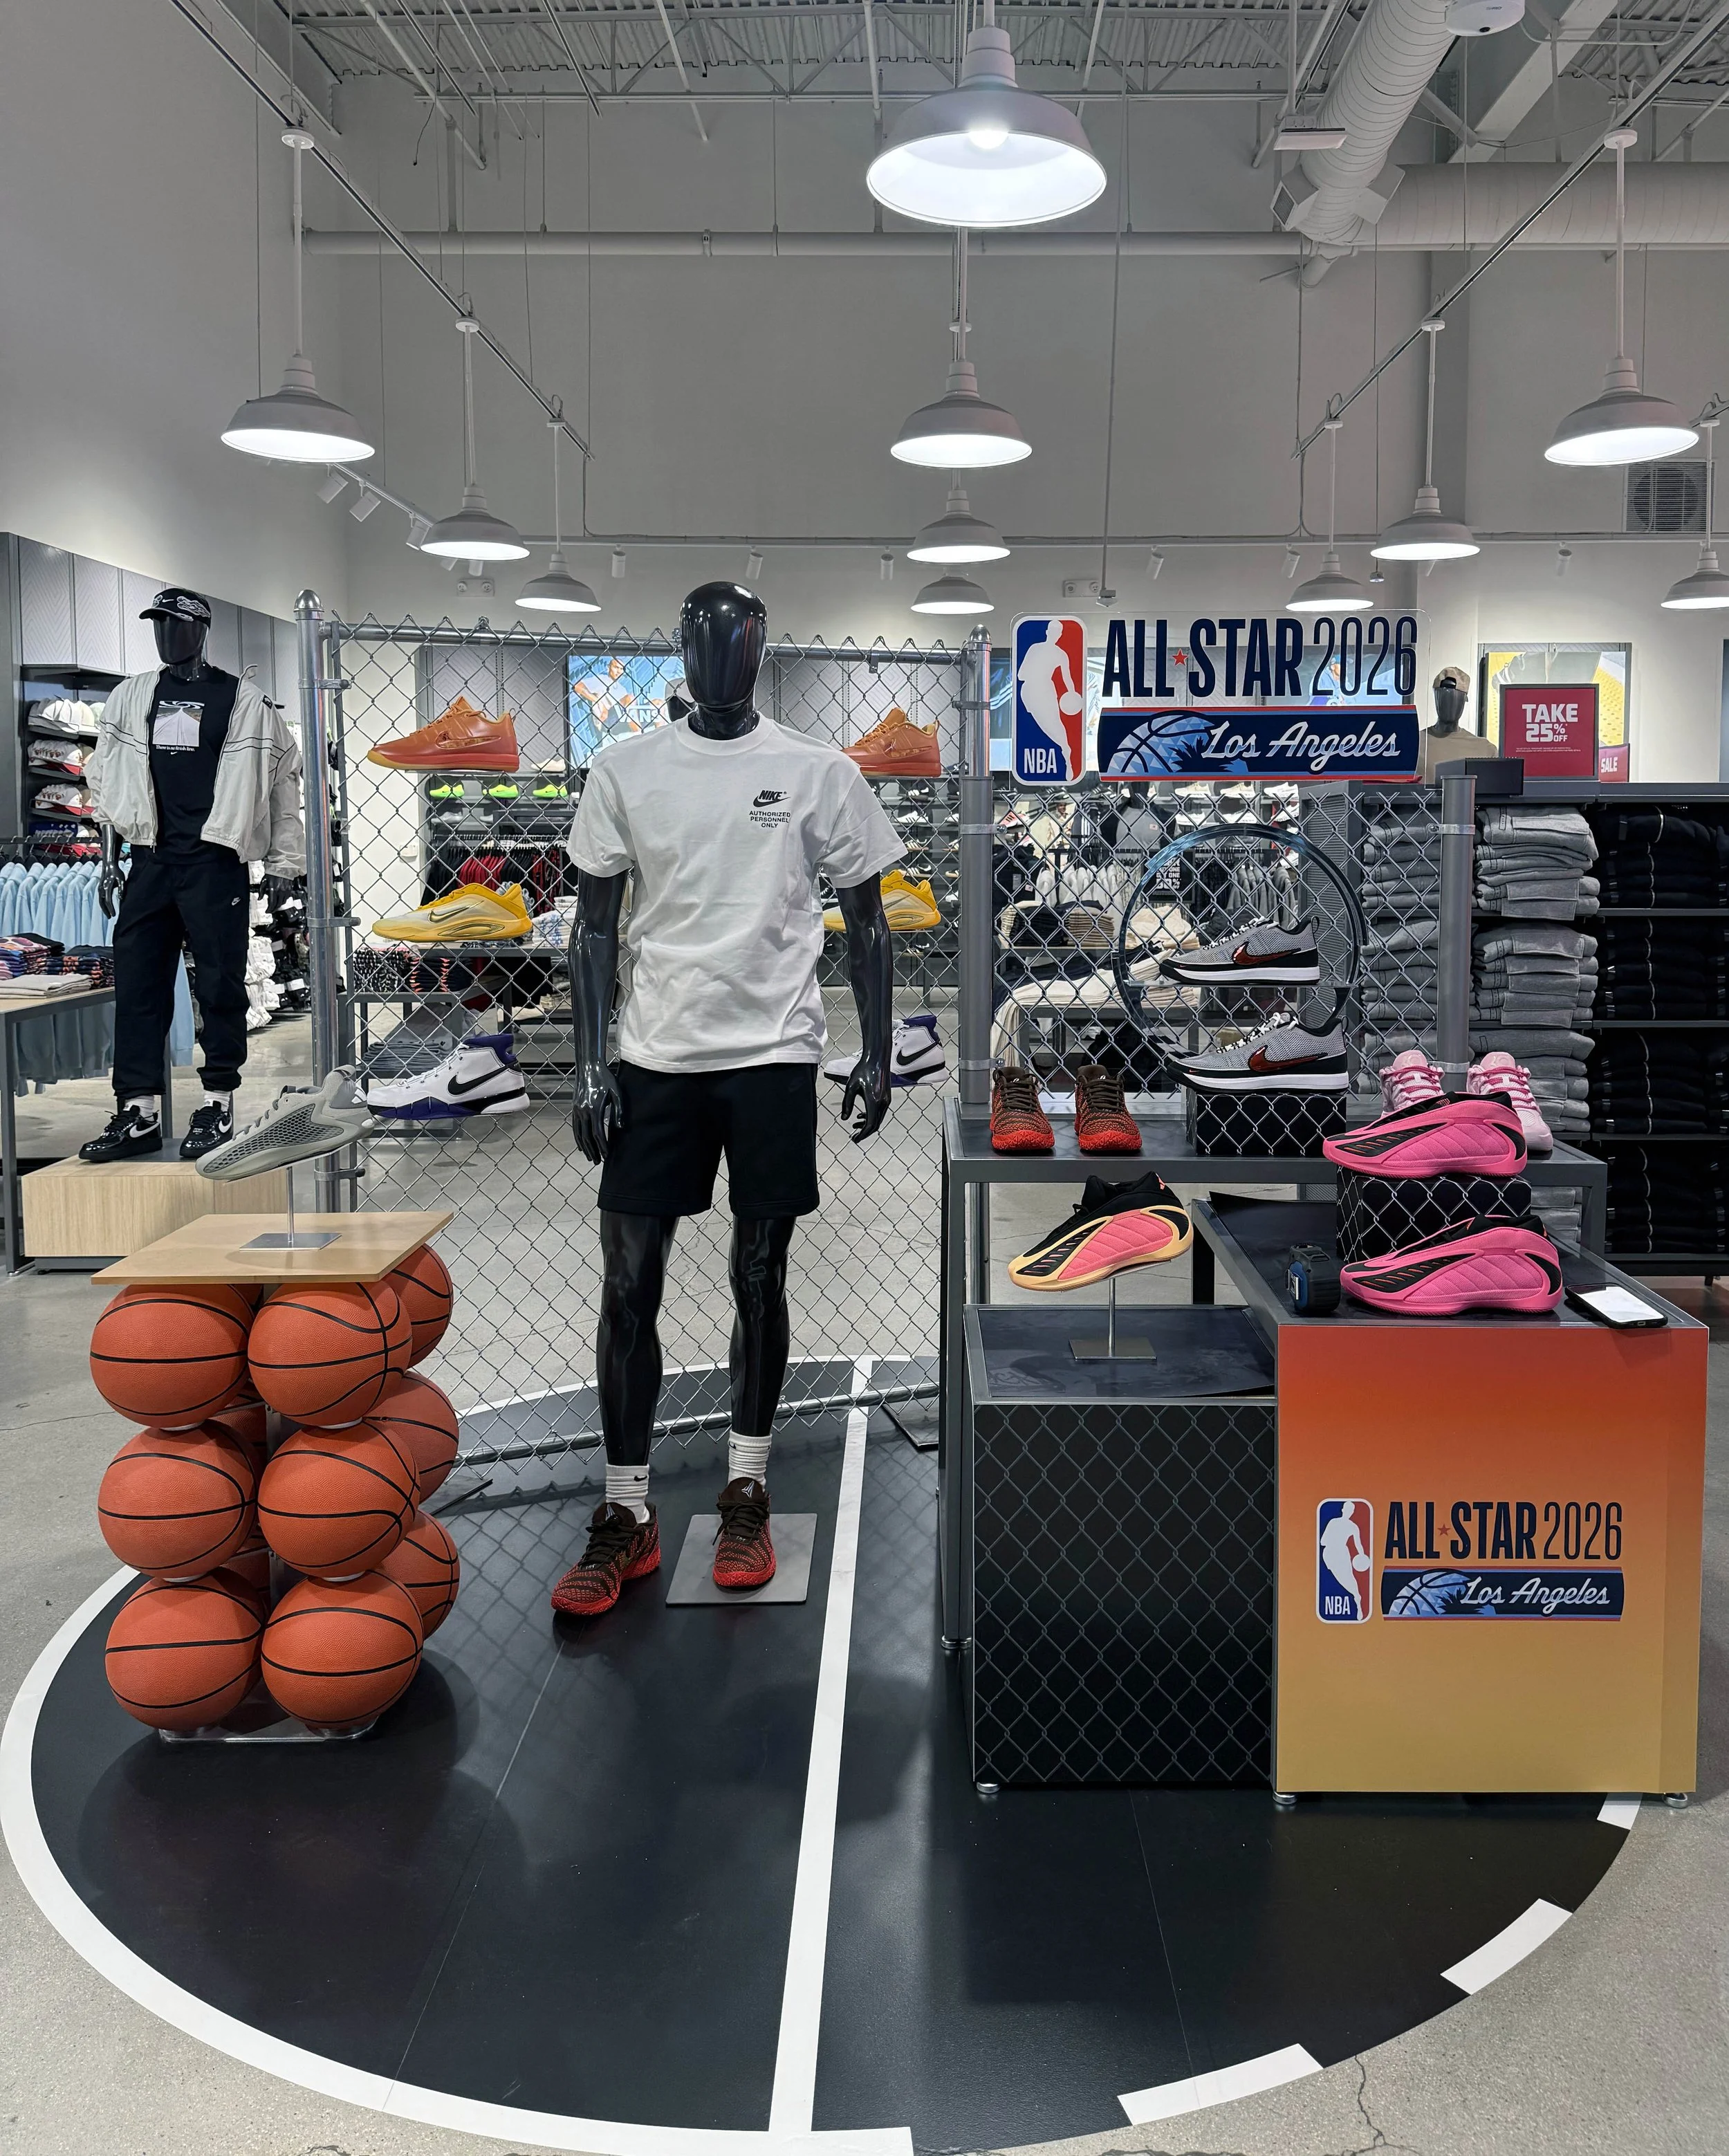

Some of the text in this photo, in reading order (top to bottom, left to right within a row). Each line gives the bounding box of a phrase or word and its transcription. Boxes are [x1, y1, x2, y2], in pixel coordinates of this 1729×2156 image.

[1102, 616, 1417, 697] ALL STAR 2026
[614, 704, 661, 723] VANS
[1522, 703, 1578, 722] TAKE
[1201, 720, 1400, 771] Los Angeles
[1024, 748, 1057, 774] NBA
[1601, 757, 1618, 773] SALE
[759, 790, 782, 800] NIKE
[1385, 1501, 1622, 1560] ALL STAR 2026
[1324, 1596, 1351, 1616] NBA
[1460, 1576, 1610, 1614] Los Angeles
